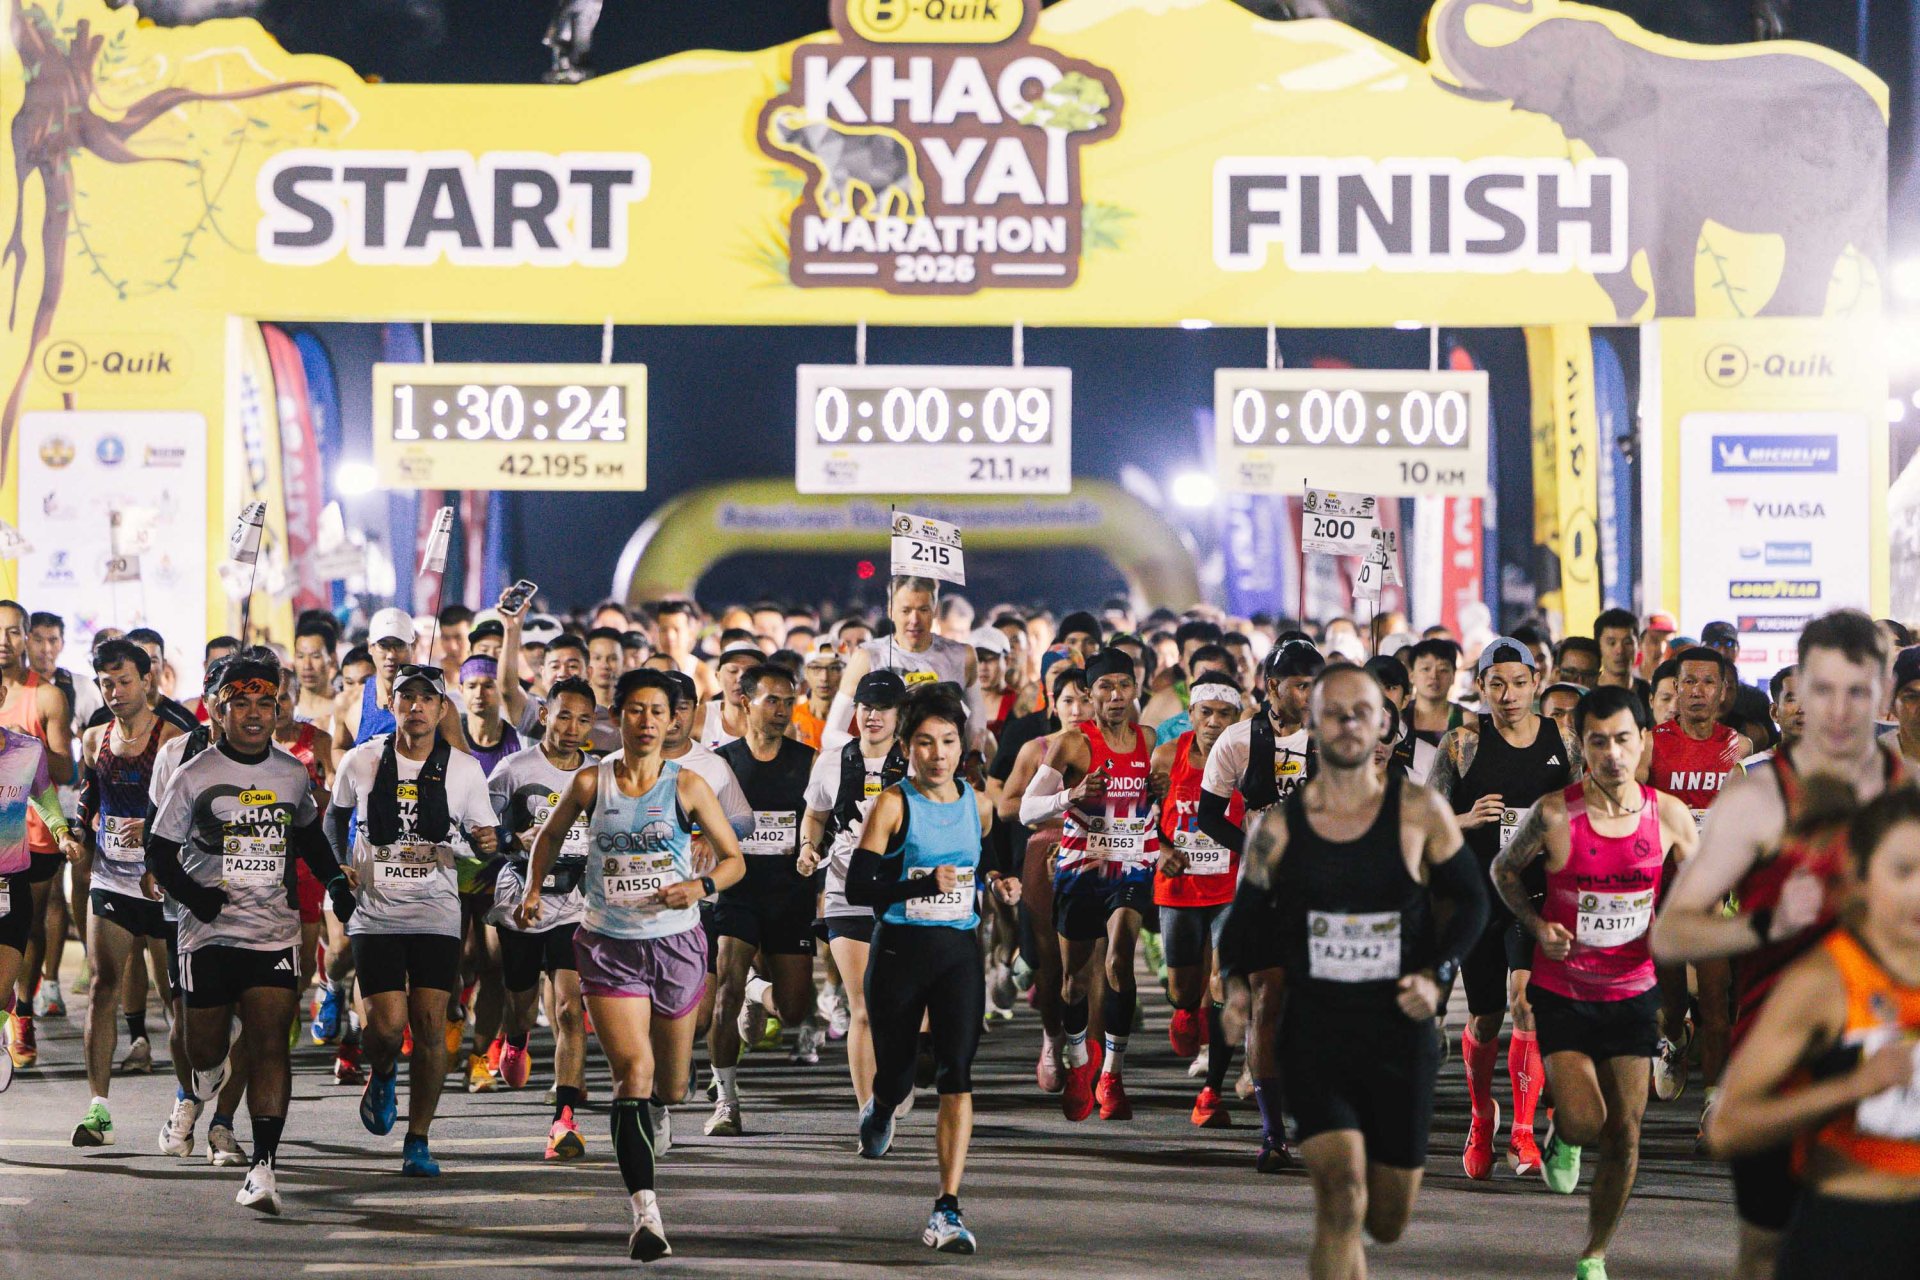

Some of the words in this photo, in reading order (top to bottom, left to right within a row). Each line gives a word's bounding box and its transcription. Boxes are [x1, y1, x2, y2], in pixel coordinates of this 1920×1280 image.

[804, 55, 1066, 123] KHAO
[920, 137, 1069, 204] YAI
[272, 165, 635, 250] START
[1229, 173, 1613, 255] FINISH
[803, 216, 1067, 253] MARATHON
[895, 254, 976, 283] 2026
[394, 384, 627, 440] 1:30:24
[815, 386, 1050, 442] 0:00:09
[1233, 388, 1467, 445] 0:00:00
[499, 455, 588, 477] 42.195
[970, 457, 1014, 481] 21.1
[1400, 462, 1428, 484] 10
[1754, 502, 1825, 518] YUASA
[1314, 518, 1355, 539] 2:00
[911, 542, 950, 565] 2:15
[1099, 838, 1134, 848] A1563
[234, 860, 276, 871] A2238
[385, 867, 428, 878] PACER
[1594, 917, 1635, 930] A3171
